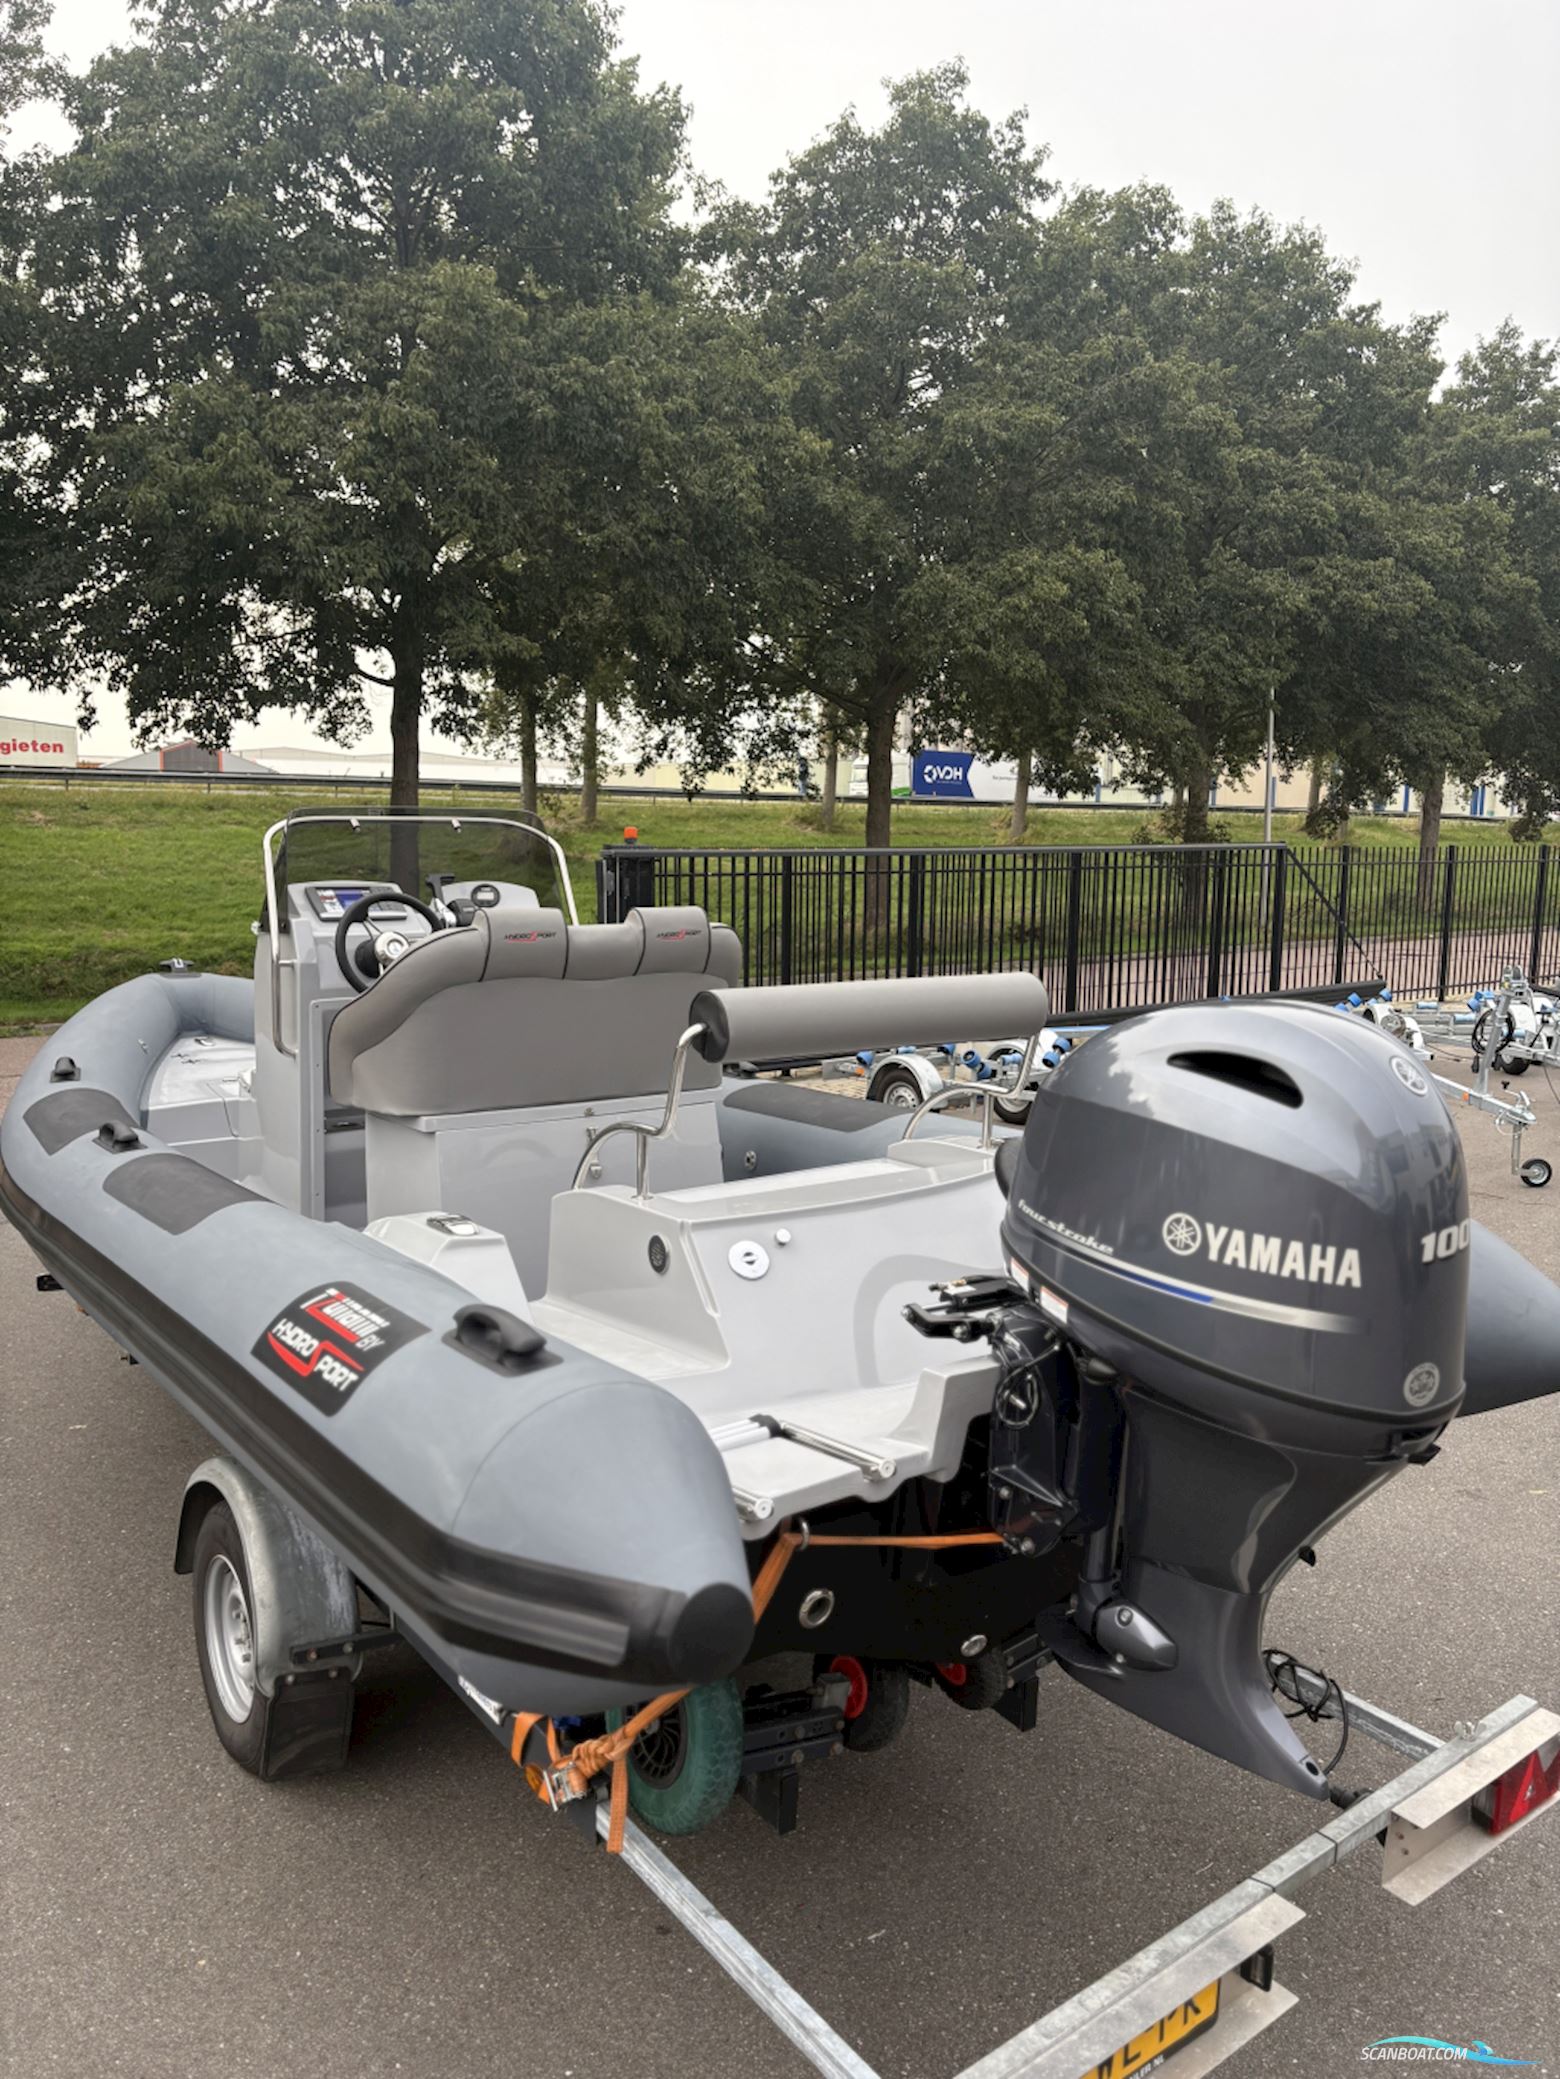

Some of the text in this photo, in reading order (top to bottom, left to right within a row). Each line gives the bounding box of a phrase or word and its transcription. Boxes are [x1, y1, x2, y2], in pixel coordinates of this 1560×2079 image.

[0, 738, 64, 755] gieten
[937, 766, 963, 780] VDH
[1421, 1219, 1470, 1263] 100
[1205, 1222, 1362, 1288] YAMAHA
[355, 1334, 386, 1351] BY
